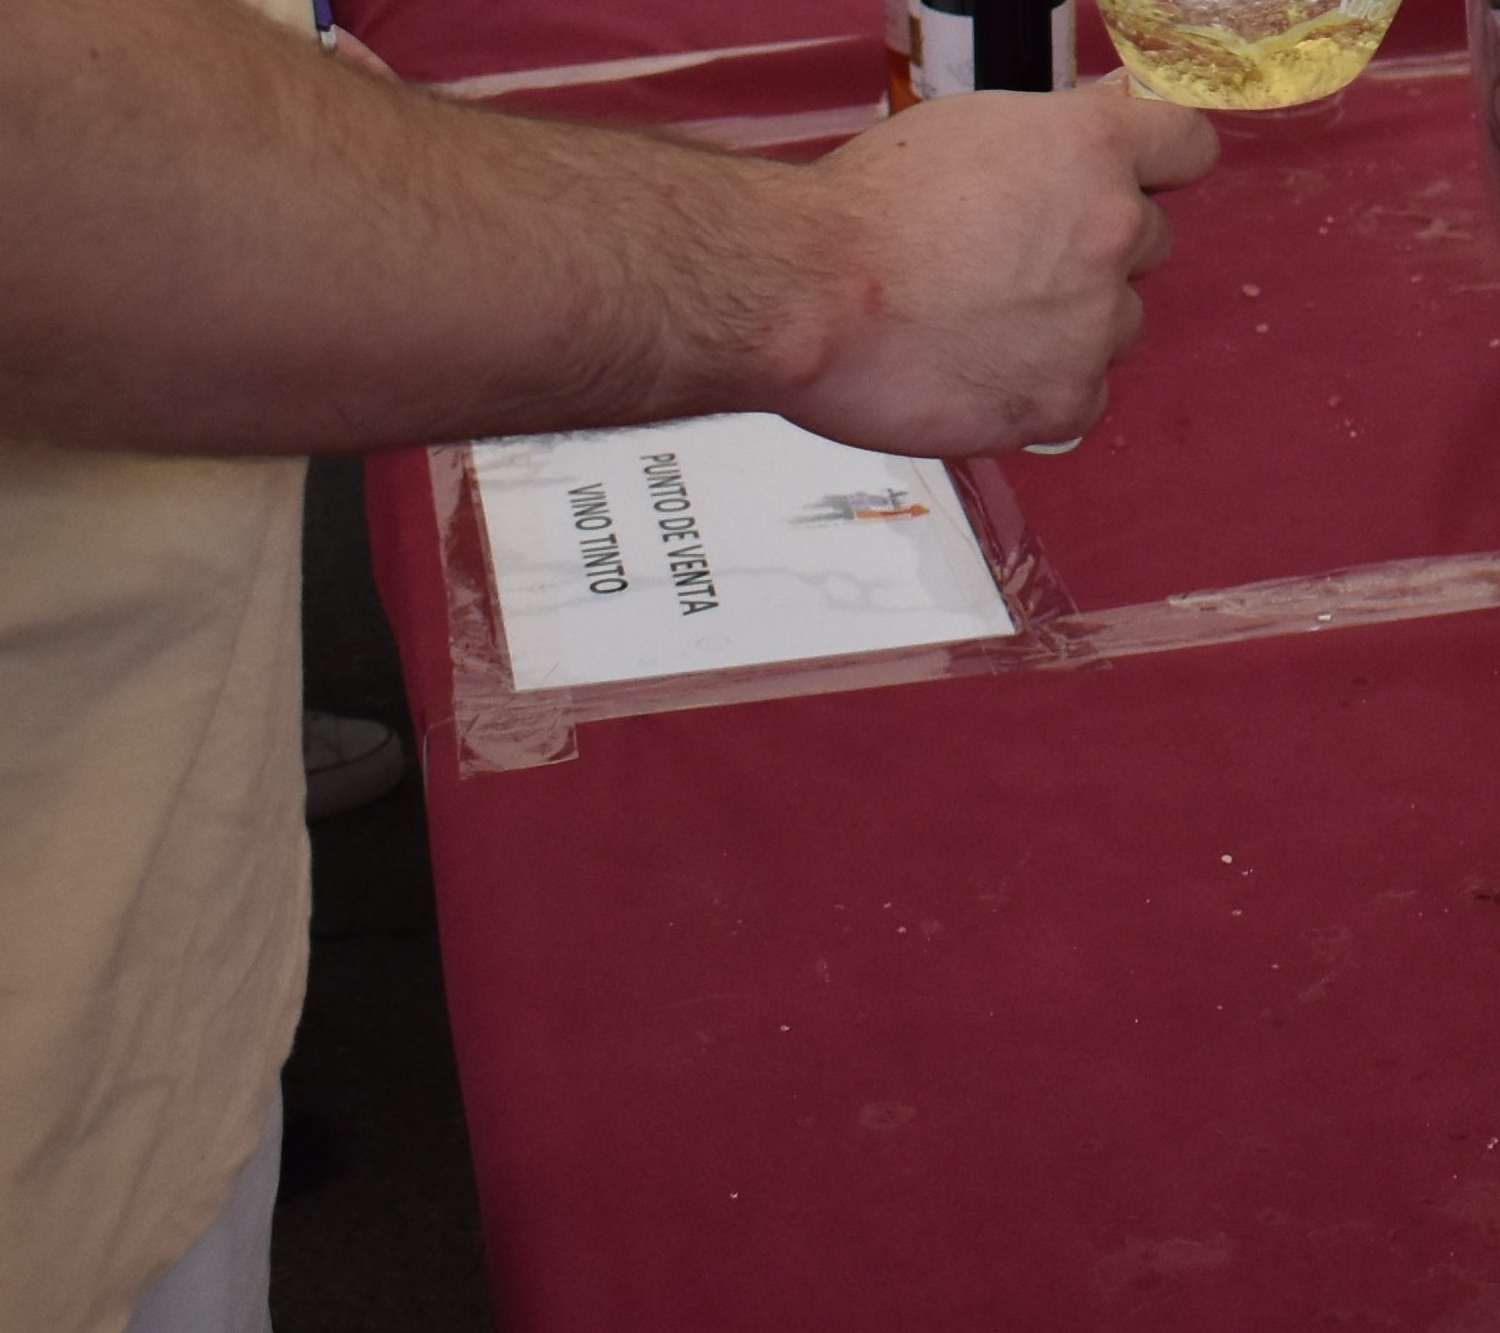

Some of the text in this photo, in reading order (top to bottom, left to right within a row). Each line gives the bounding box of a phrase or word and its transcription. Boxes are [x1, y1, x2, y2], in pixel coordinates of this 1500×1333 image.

[567, 481, 629, 595] VINO TINTO
[639, 452, 720, 617] PUNTO DE VENTA
